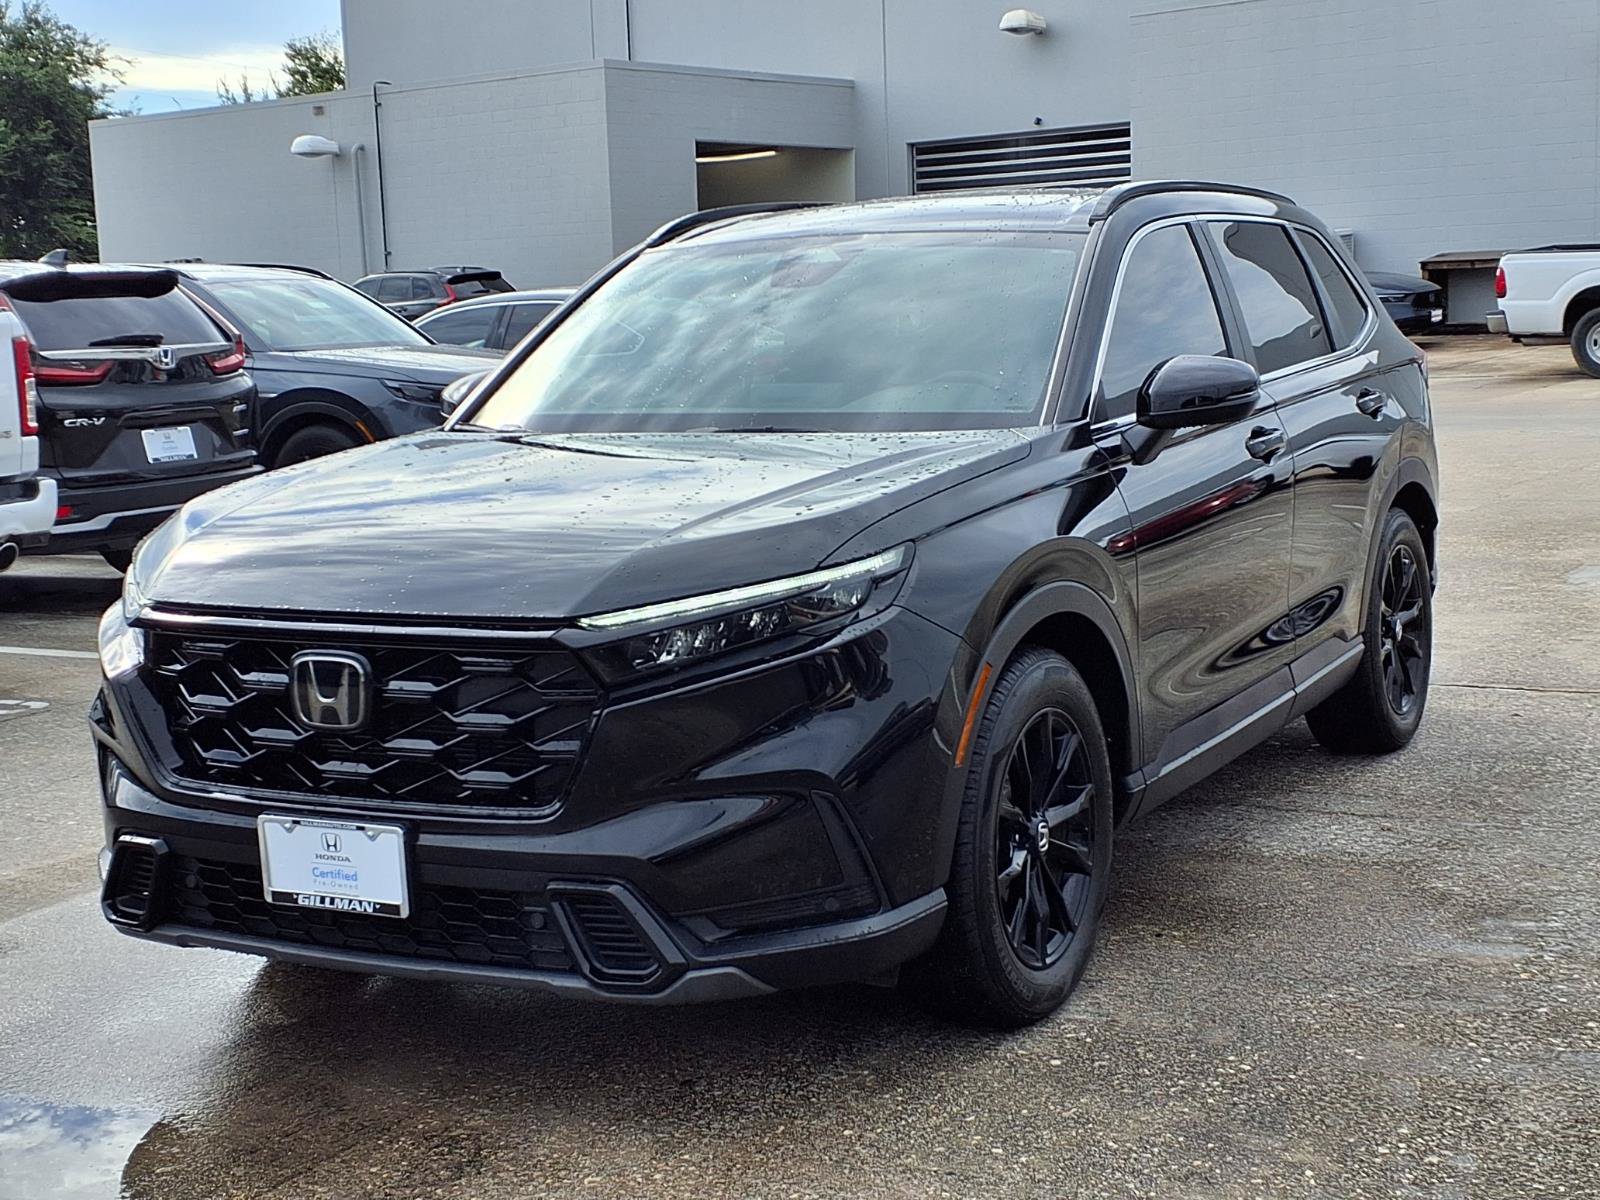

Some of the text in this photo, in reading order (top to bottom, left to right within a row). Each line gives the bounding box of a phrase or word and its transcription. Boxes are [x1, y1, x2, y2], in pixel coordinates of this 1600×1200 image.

[63, 416, 106, 427] CR-V
[315, 853, 352, 863] HONDA
[312, 866, 358, 882] Certified
[297, 893, 374, 913] GILLMAN
